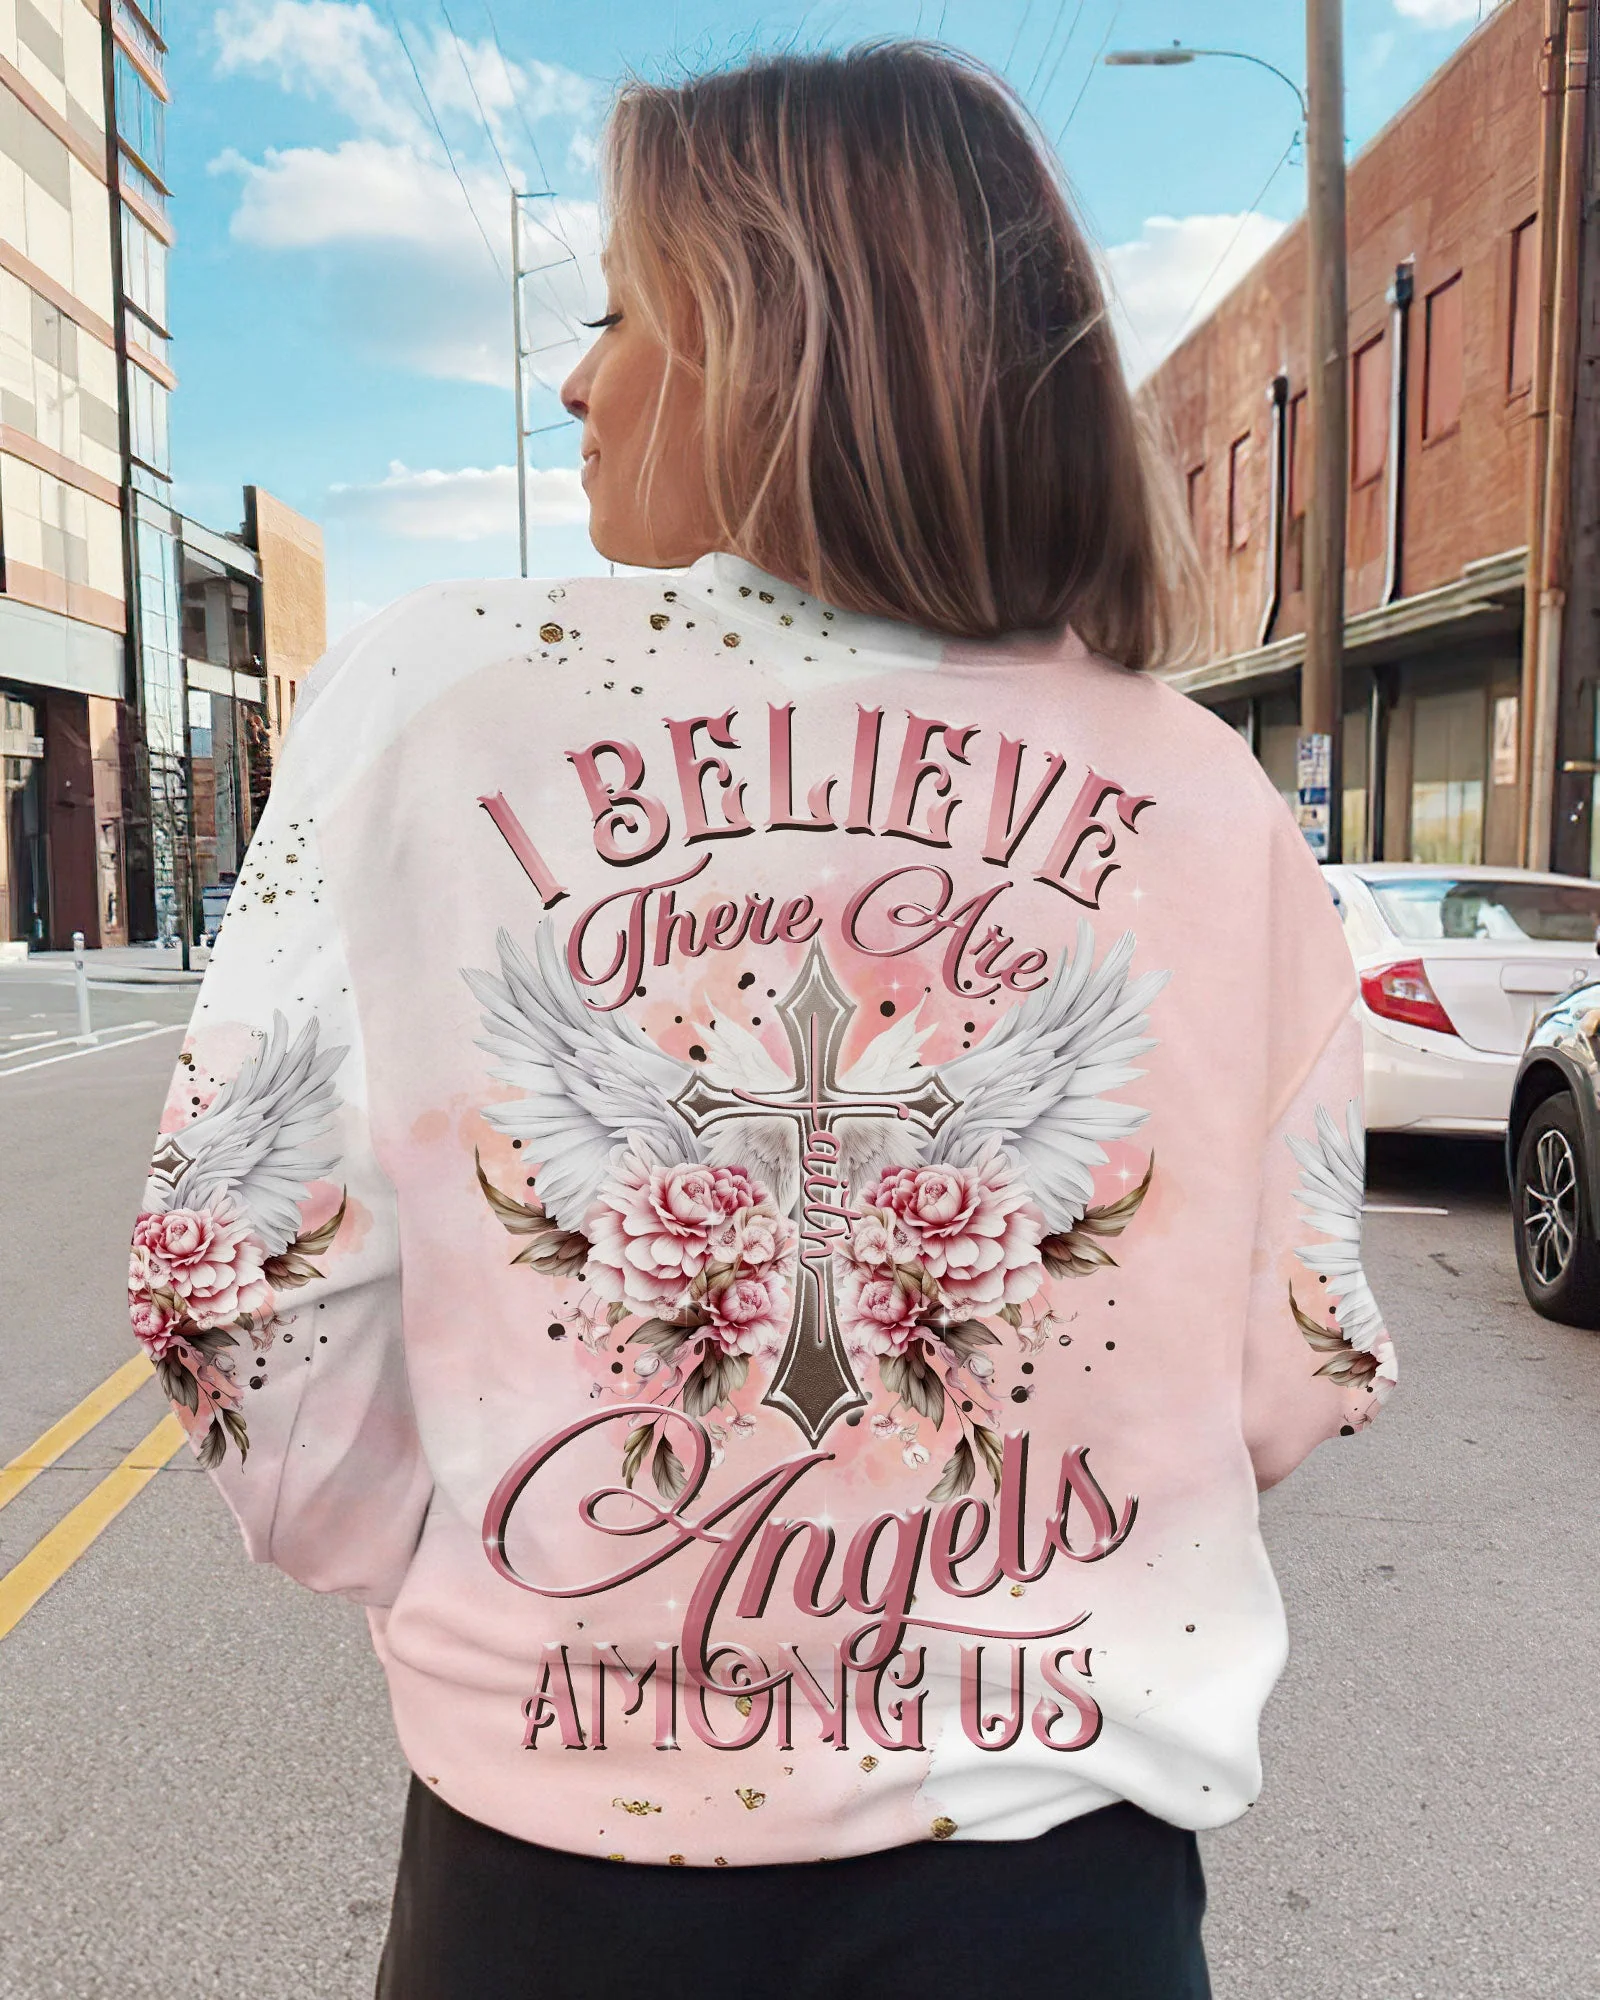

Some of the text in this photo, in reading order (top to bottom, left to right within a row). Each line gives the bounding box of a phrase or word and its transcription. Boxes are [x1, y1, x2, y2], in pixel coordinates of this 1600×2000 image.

[477, 789, 569, 910] I
[564, 701, 1157, 910] BELIEVE
[566, 852, 1050, 1012] There Are
[482, 1403, 1138, 1696] Angels
[520, 1641, 1103, 1753] AMONG US
